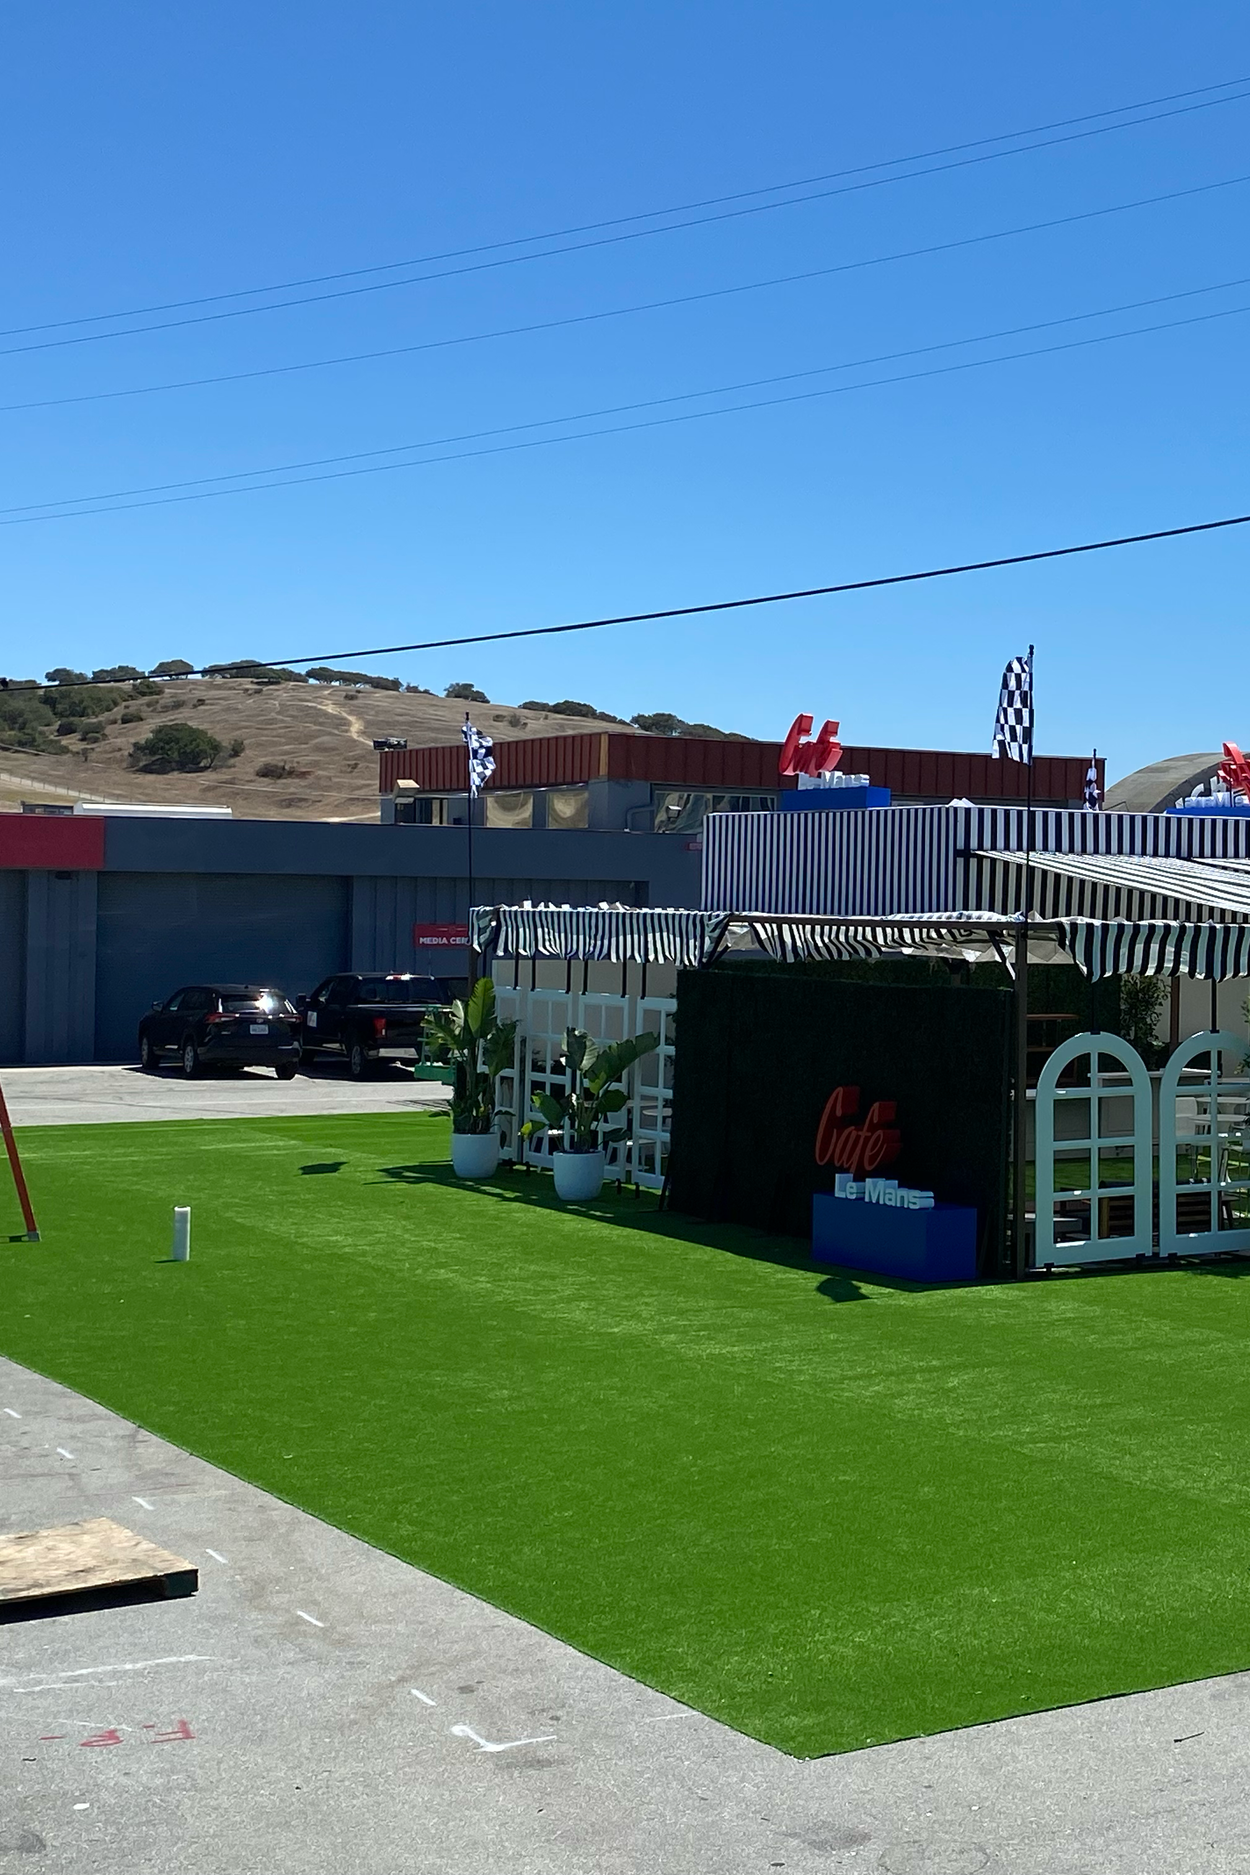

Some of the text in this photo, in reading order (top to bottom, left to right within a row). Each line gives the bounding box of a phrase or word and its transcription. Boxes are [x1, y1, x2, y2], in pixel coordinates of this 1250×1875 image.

[419, 936, 448, 945] MEDIA
[815, 1085, 895, 1175] Cafe
[835, 1172, 928, 1210] Le Mans
